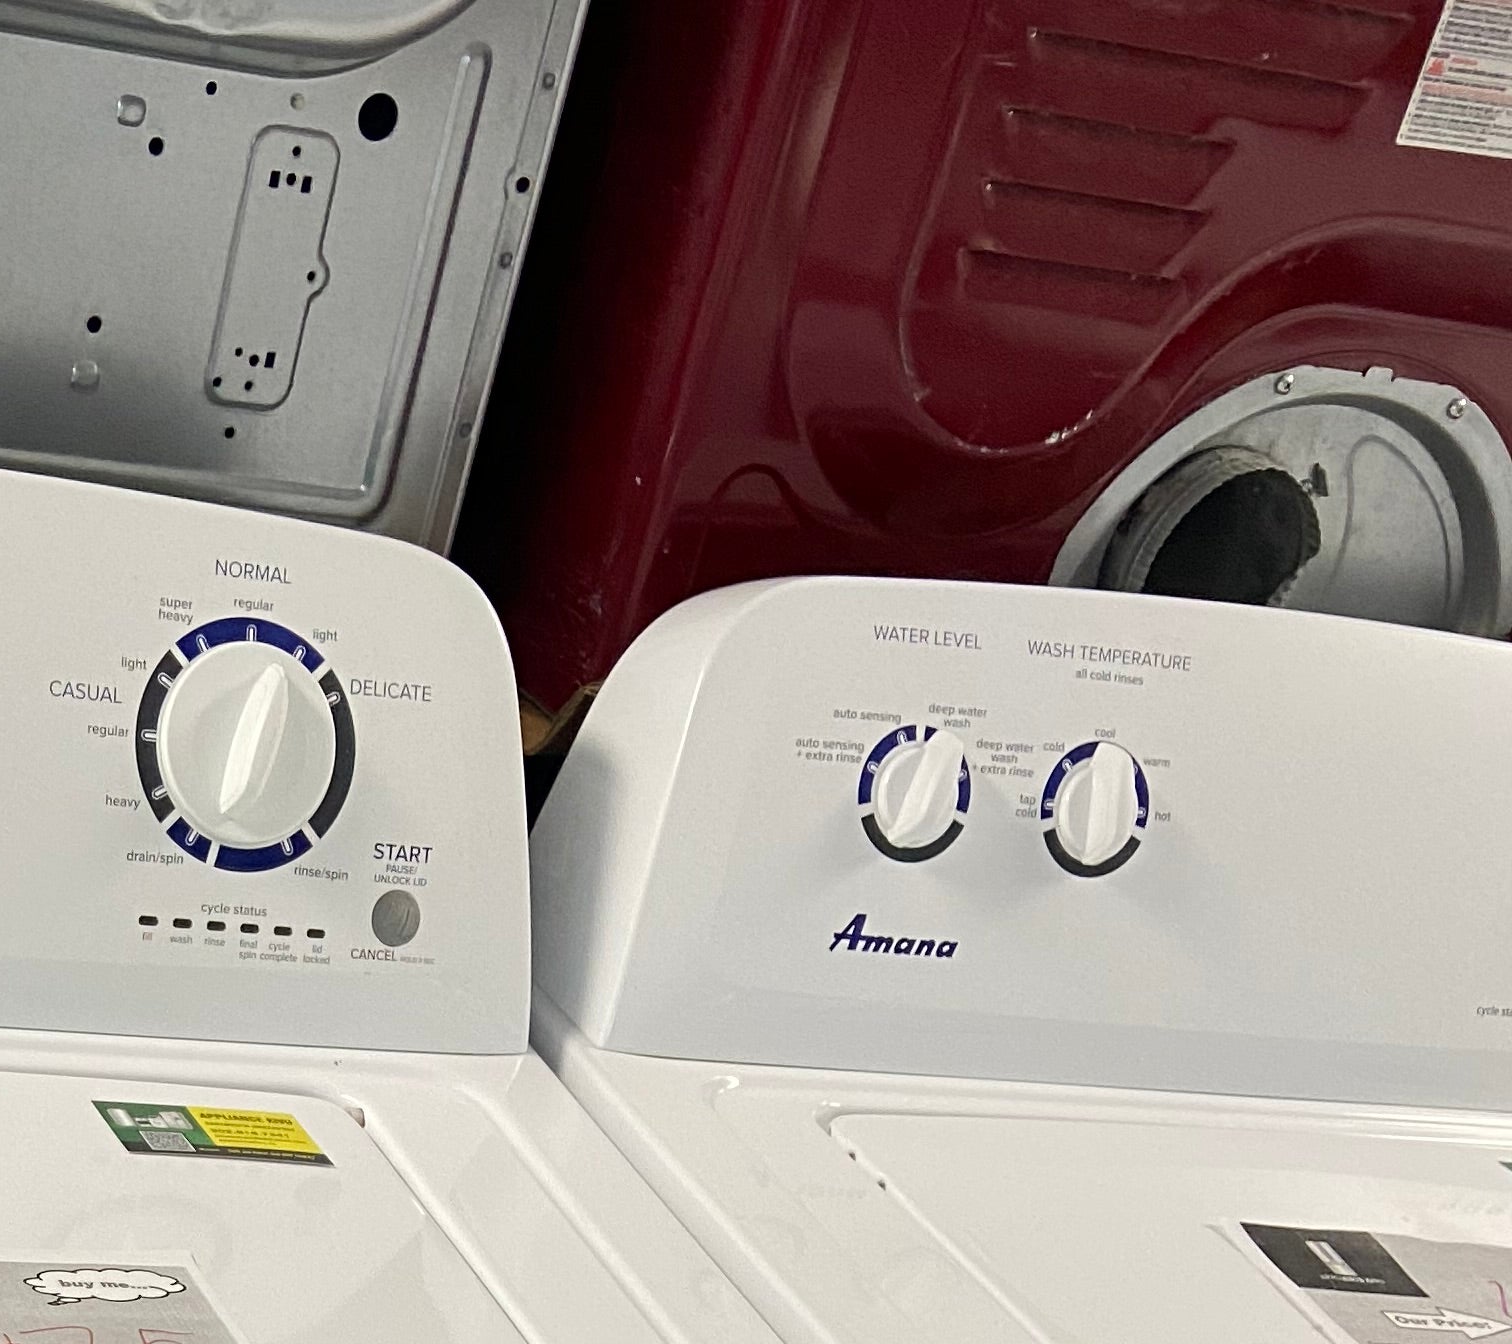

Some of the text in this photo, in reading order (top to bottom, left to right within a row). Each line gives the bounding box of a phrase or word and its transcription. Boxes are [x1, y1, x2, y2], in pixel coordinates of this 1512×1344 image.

[214, 559, 292, 585] NORMAL
[159, 598, 194, 611] super
[233, 599, 275, 613] regular
[158, 609, 194, 626] heavy
[312, 628, 339, 644] light
[874, 625, 982, 651] WATER LEVEL
[1028, 640, 1192, 672] WASH TEMPERATURE
[121, 657, 148, 672] light
[1075, 668, 1144, 686] all cold rinses
[49, 679, 123, 705] CASUAL
[349, 678, 433, 703] DELICATE
[832, 708, 902, 725] auto sensing
[928, 703, 987, 718] deep water
[943, 717, 971, 728] wash
[87, 724, 130, 740] regular
[1095, 726, 1116, 739] cool
[795, 737, 865, 755] auto sensing
[976, 738, 1034, 753] deep water
[1043, 739, 1065, 753] cold
[805, 750, 833, 761] extra
[836, 751, 862, 764] rinse
[991, 754, 1018, 764] wash
[1144, 757, 1170, 768] warm
[980, 765, 1007, 776] extra
[1009, 766, 1034, 778] rinse
[105, 794, 142, 812] heavy
[1020, 793, 1036, 808] tap
[1015, 806, 1037, 819] cold
[1155, 810, 1171, 822] hot
[126, 849, 185, 867] drain/spin
[373, 842, 434, 864] START
[293, 865, 350, 883] rinse/spin
[374, 873, 411, 886] UNLOCK
[201, 902, 268, 918] cycle status
[829, 913, 959, 959] Amana
[350, 948, 398, 962] CANCEL
[58, 1279, 94, 1290] buy
